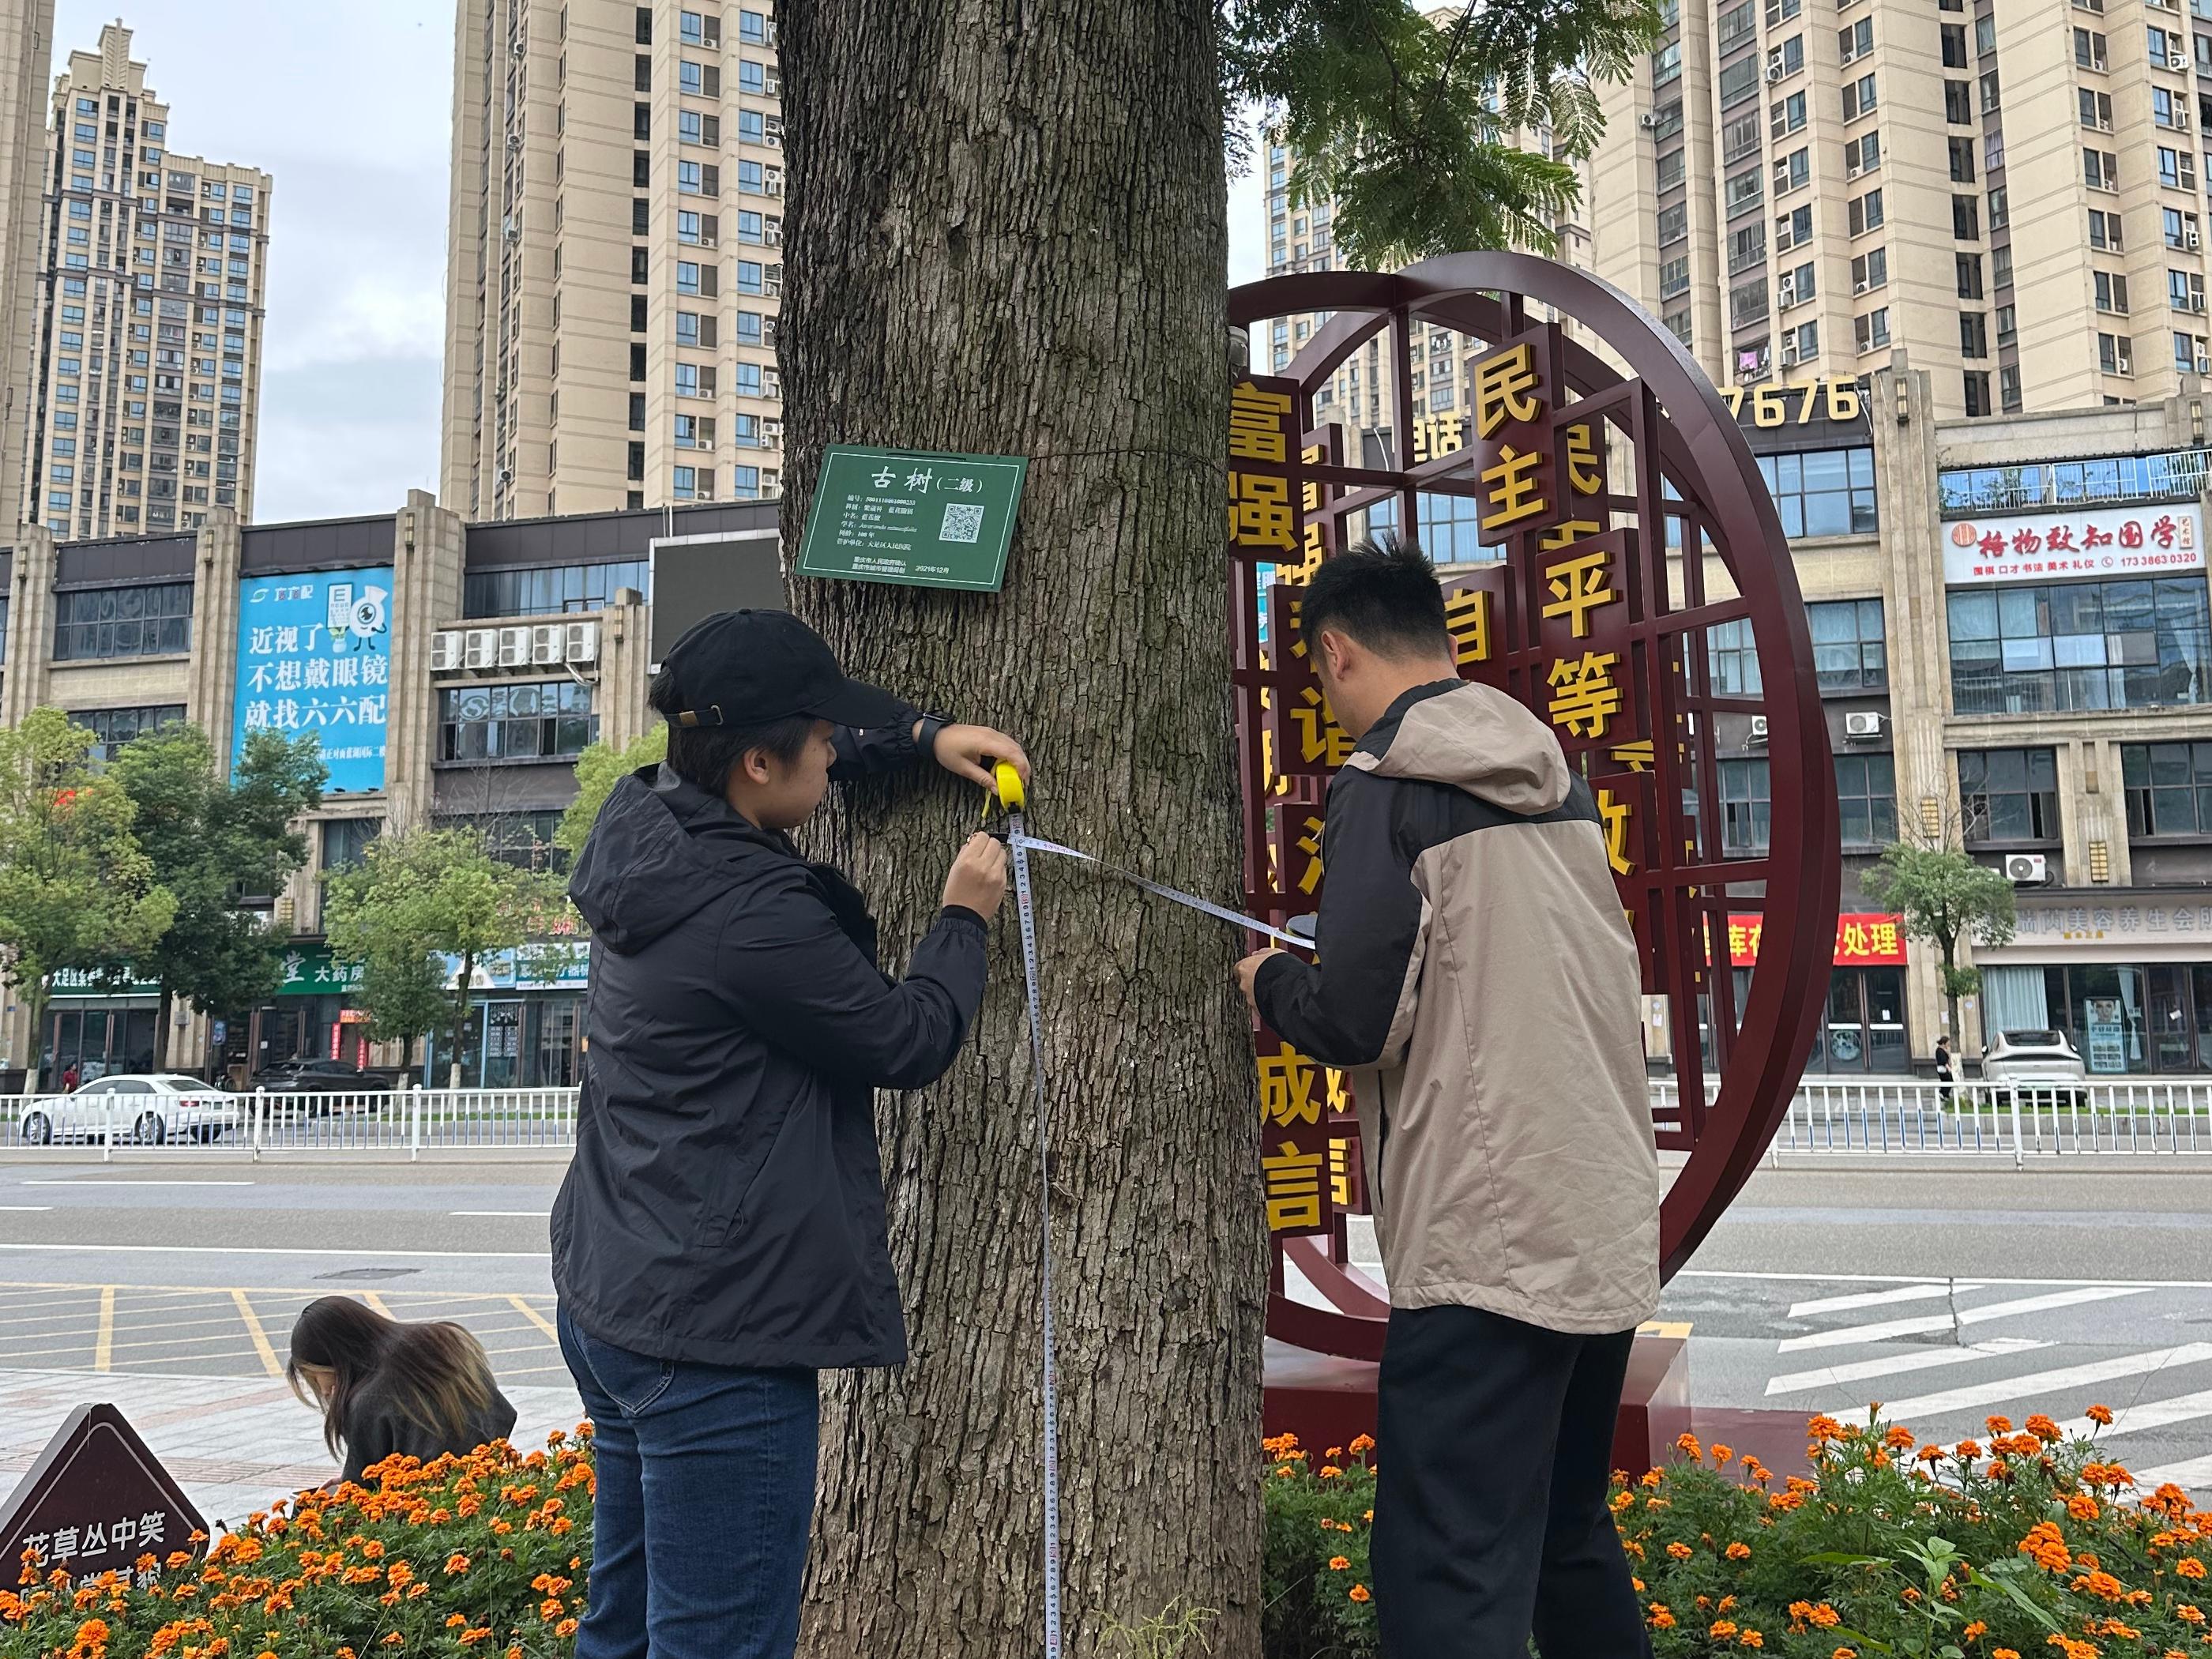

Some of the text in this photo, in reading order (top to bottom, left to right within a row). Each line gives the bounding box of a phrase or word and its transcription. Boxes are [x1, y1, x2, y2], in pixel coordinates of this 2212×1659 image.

[1475, 343, 1548, 532] 民主
[1229, 382, 1298, 551] 富强
[1977, 515, 2177, 559] 格物致知国学
[1973, 566, 1995, 576] 围棋
[1999, 565, 2019, 574] 口才
[2022, 563, 2043, 573] 书法
[2072, 559, 2094, 570] 礼仪
[249, 623, 324, 655] 近视了
[1543, 551, 1620, 739] 平等
[246, 654, 388, 693] 不想戴眼镜
[244, 694, 386, 732] 就找六六配
[1834, 923, 1899, 957] 处理
[22, 1510, 166, 1567] 花草丛中笑
